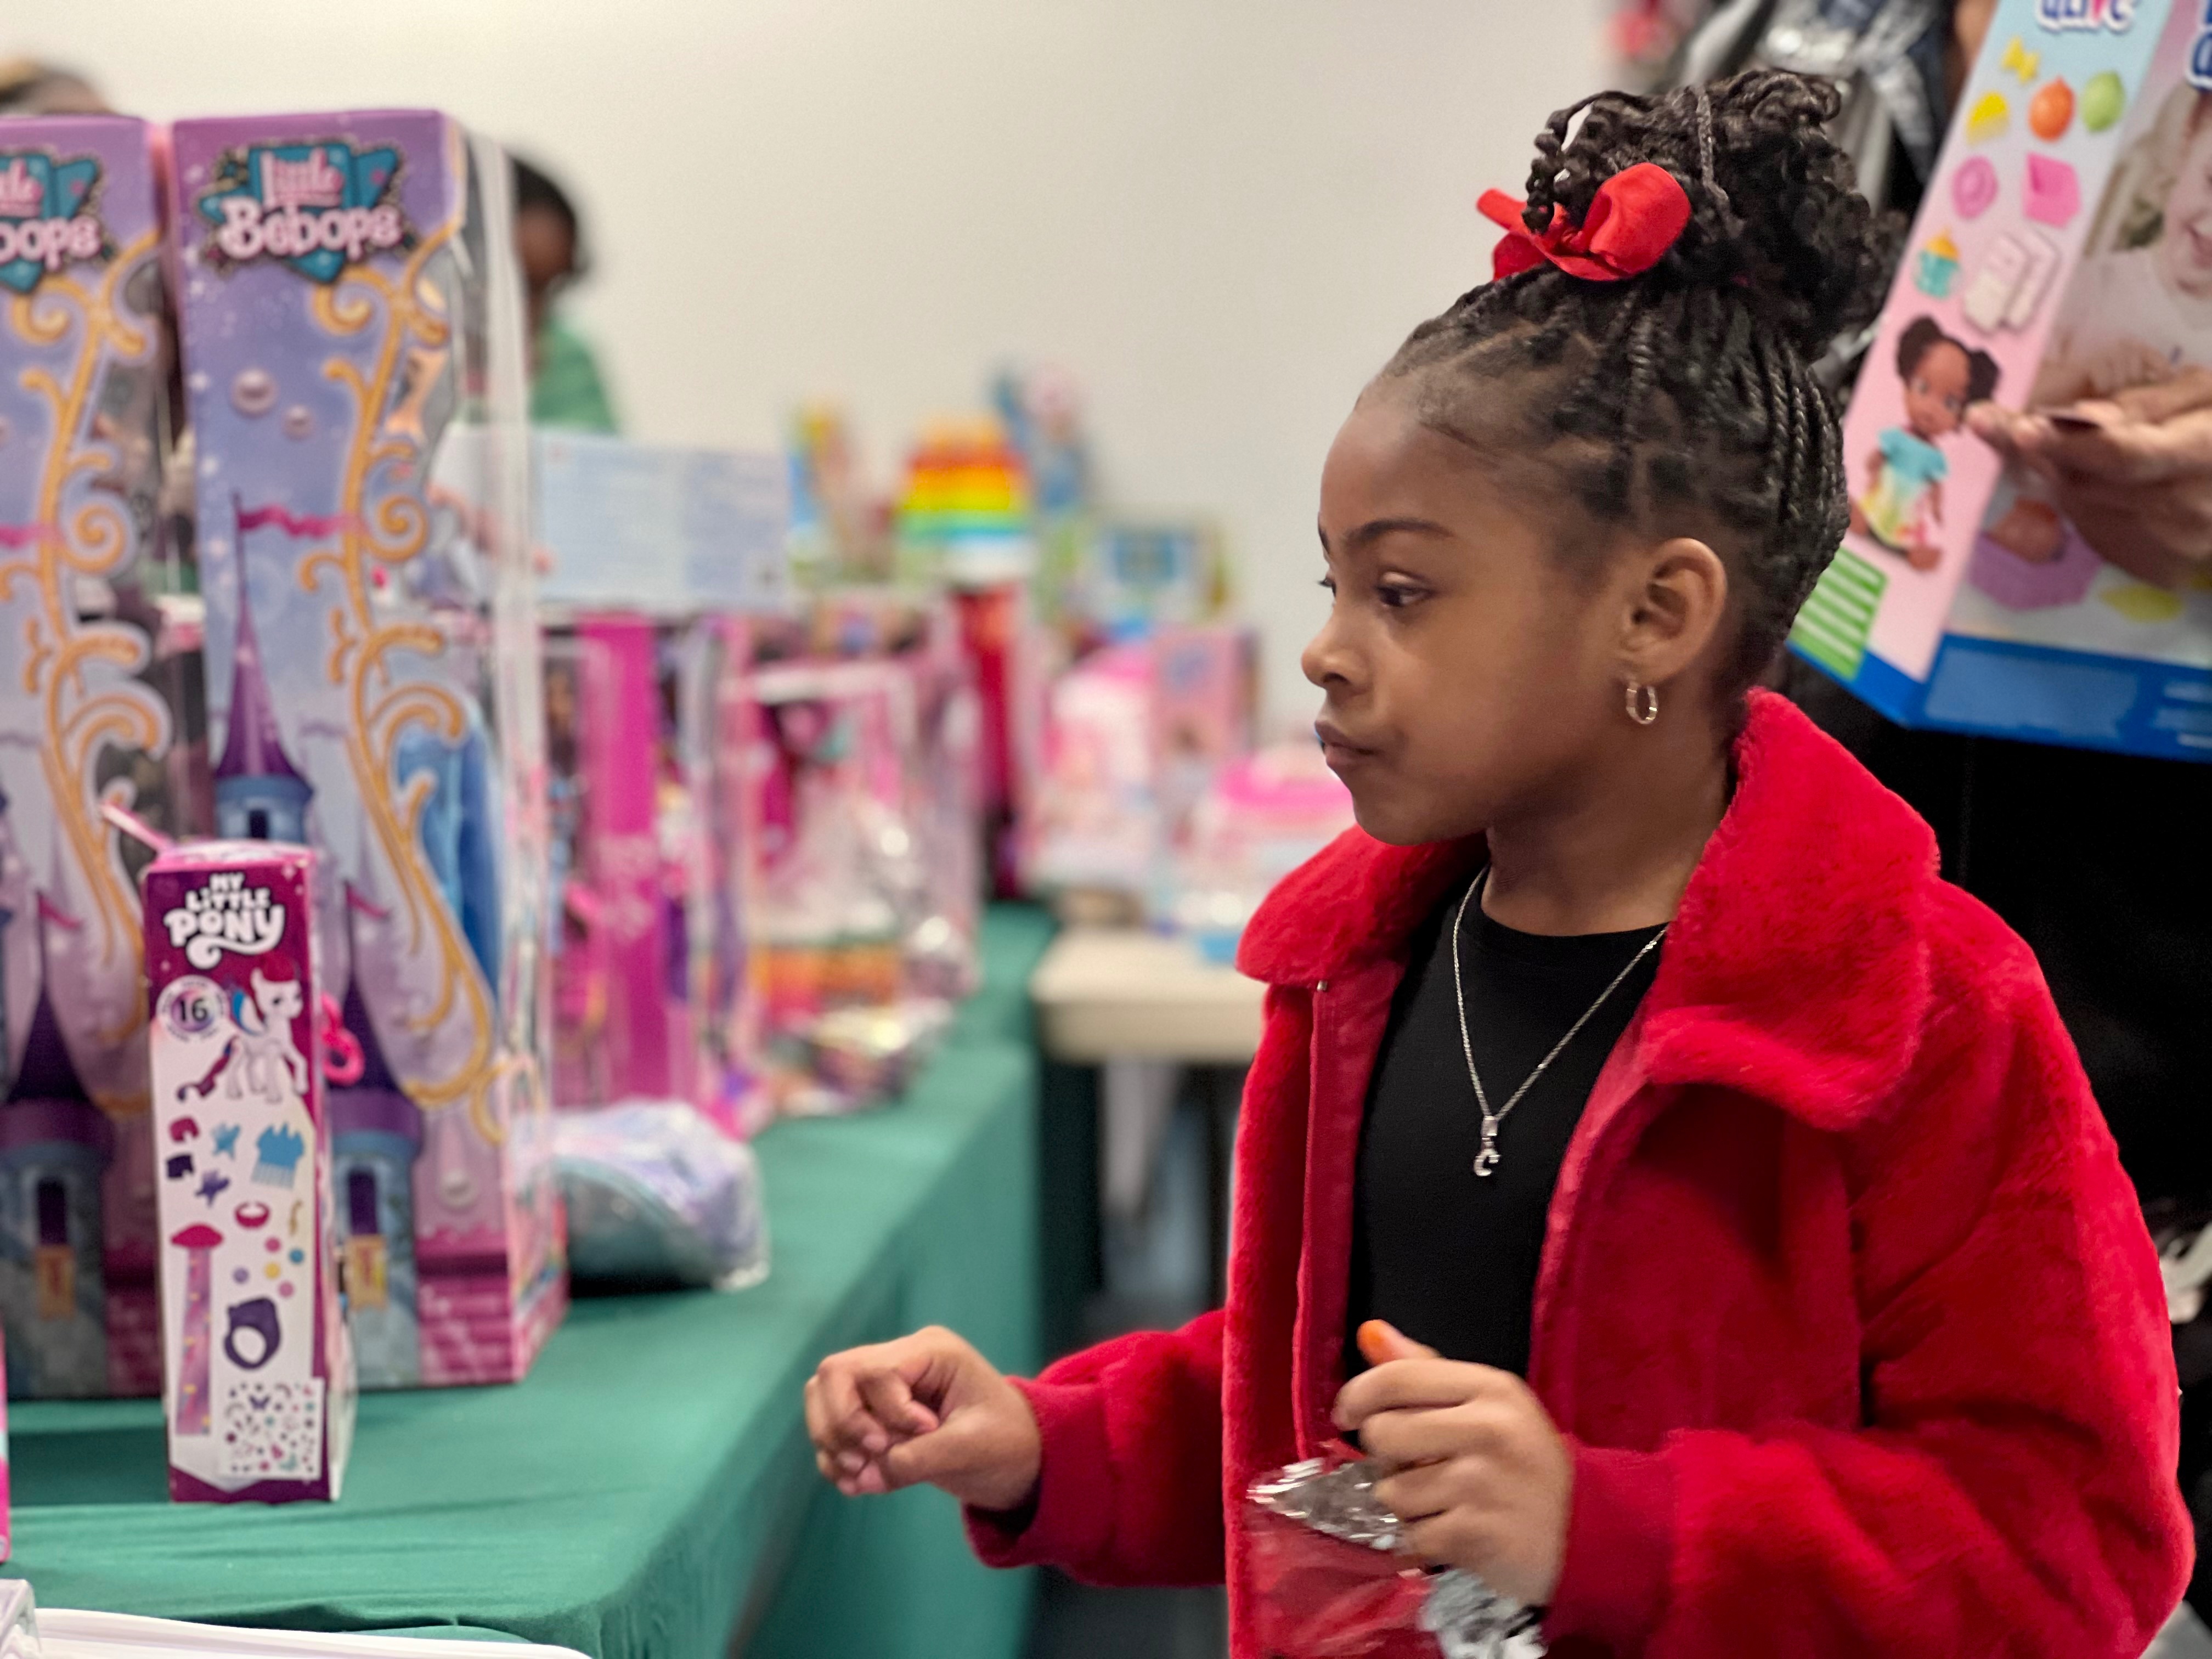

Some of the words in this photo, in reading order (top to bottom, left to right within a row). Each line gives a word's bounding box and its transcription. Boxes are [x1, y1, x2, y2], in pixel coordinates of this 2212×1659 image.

[219, 196, 403, 260] Bebops
[209, 872, 245, 893] MY
[163, 905, 285, 969] PONY
[180, 998, 208, 1023] 16
